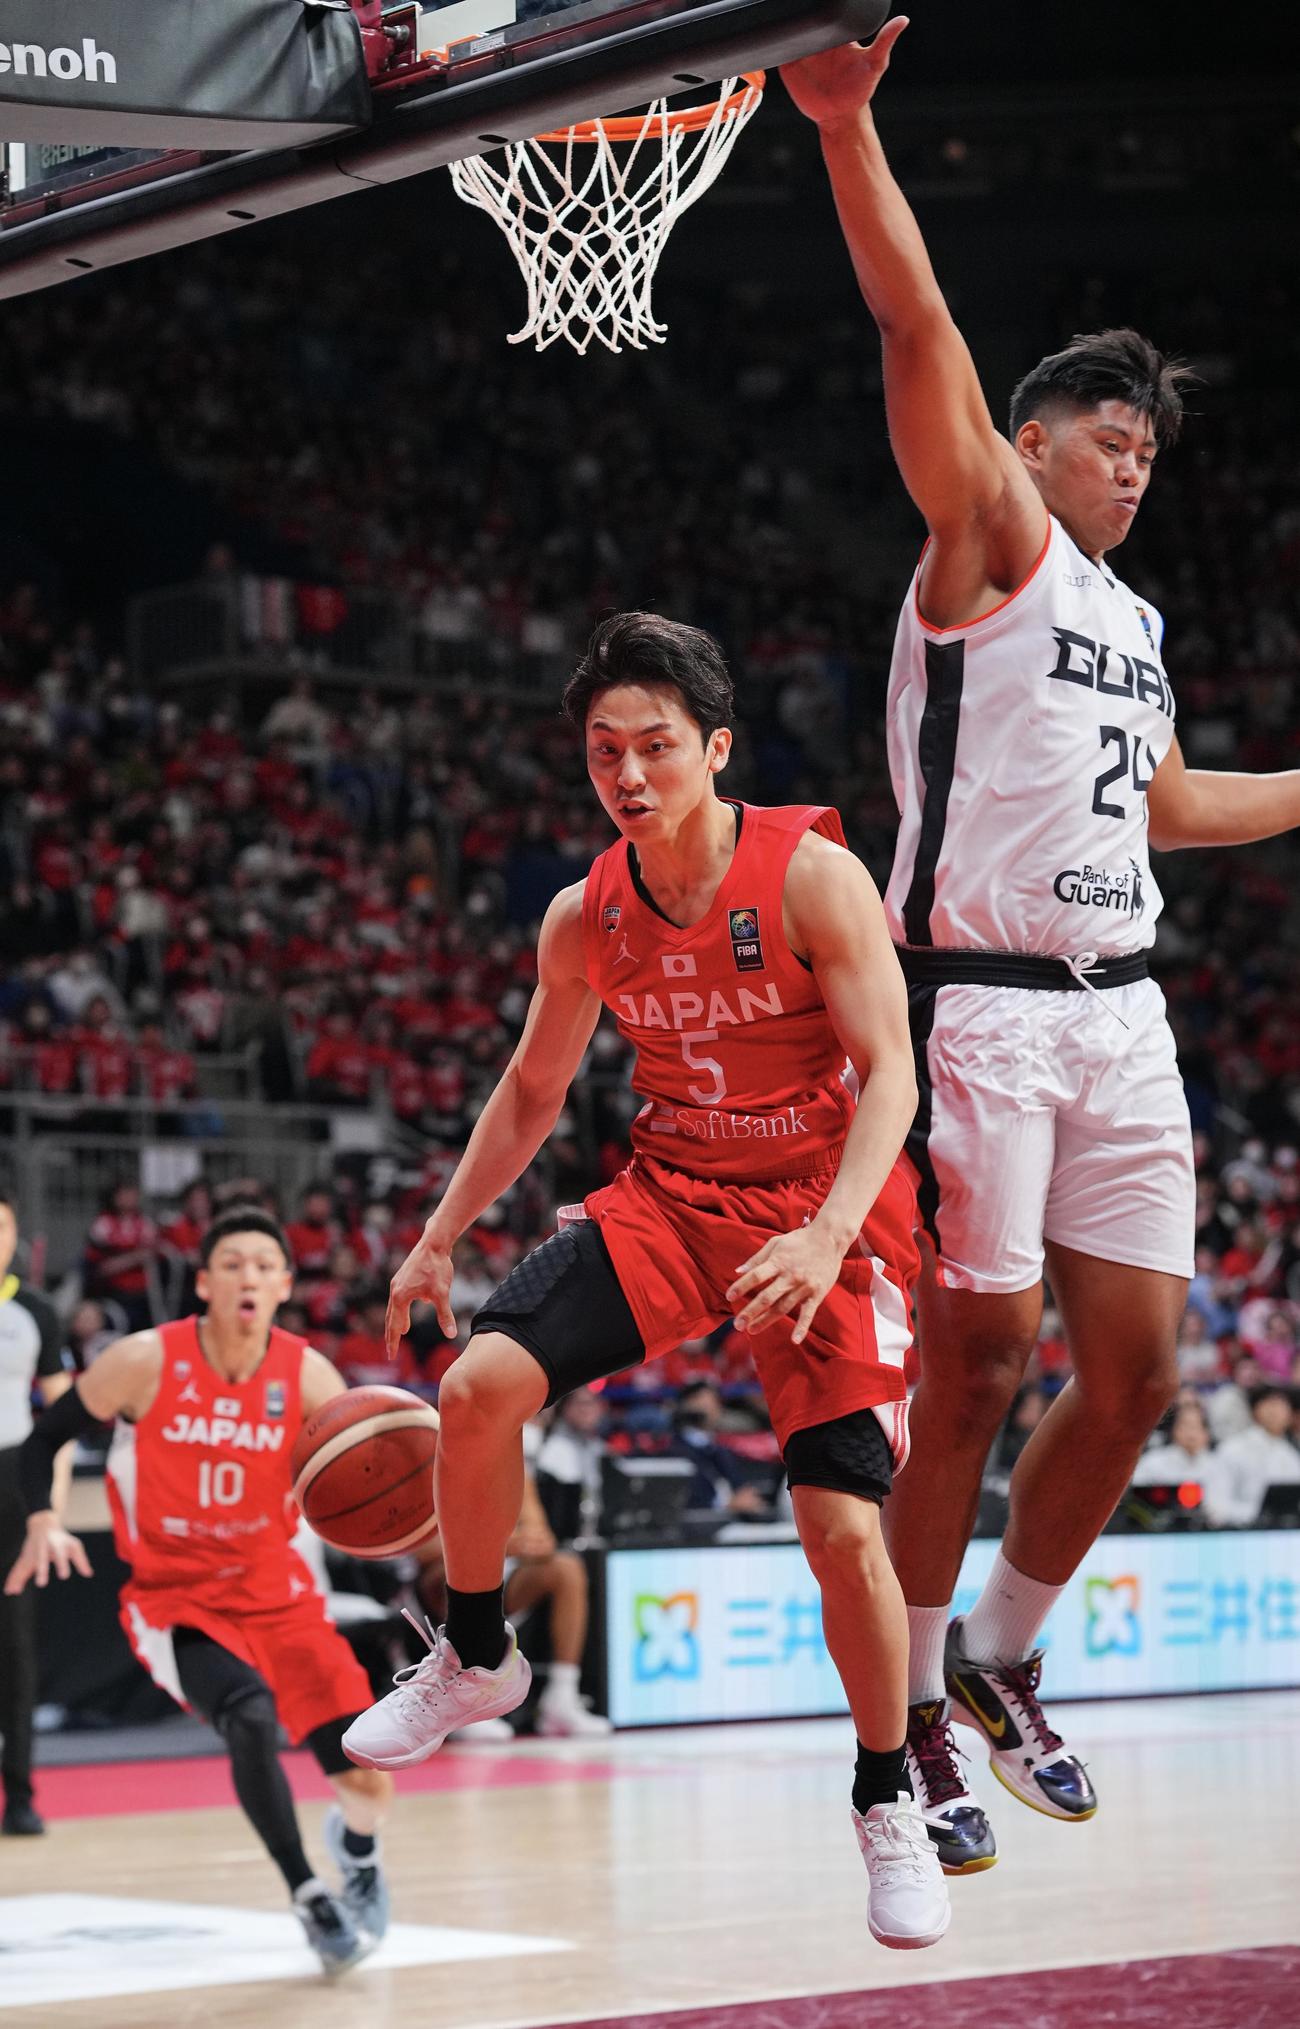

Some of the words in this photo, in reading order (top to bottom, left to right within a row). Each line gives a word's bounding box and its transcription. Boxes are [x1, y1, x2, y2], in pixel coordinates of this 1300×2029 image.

[1046, 626, 1172, 718] GUA
[1092, 725, 1157, 820] 24
[1053, 870, 1128, 911] Guam
[1082, 865, 1112, 885] Bank
[1115, 874, 1129, 888] of
[737, 944, 758, 957] FIBA
[615, 982, 784, 1030] JAPAN
[680, 1029, 727, 1105] 5
[676, 1106, 810, 1139] SoftBank
[162, 1414, 285, 1451] JAPAN
[198, 1460, 245, 1508] 10
